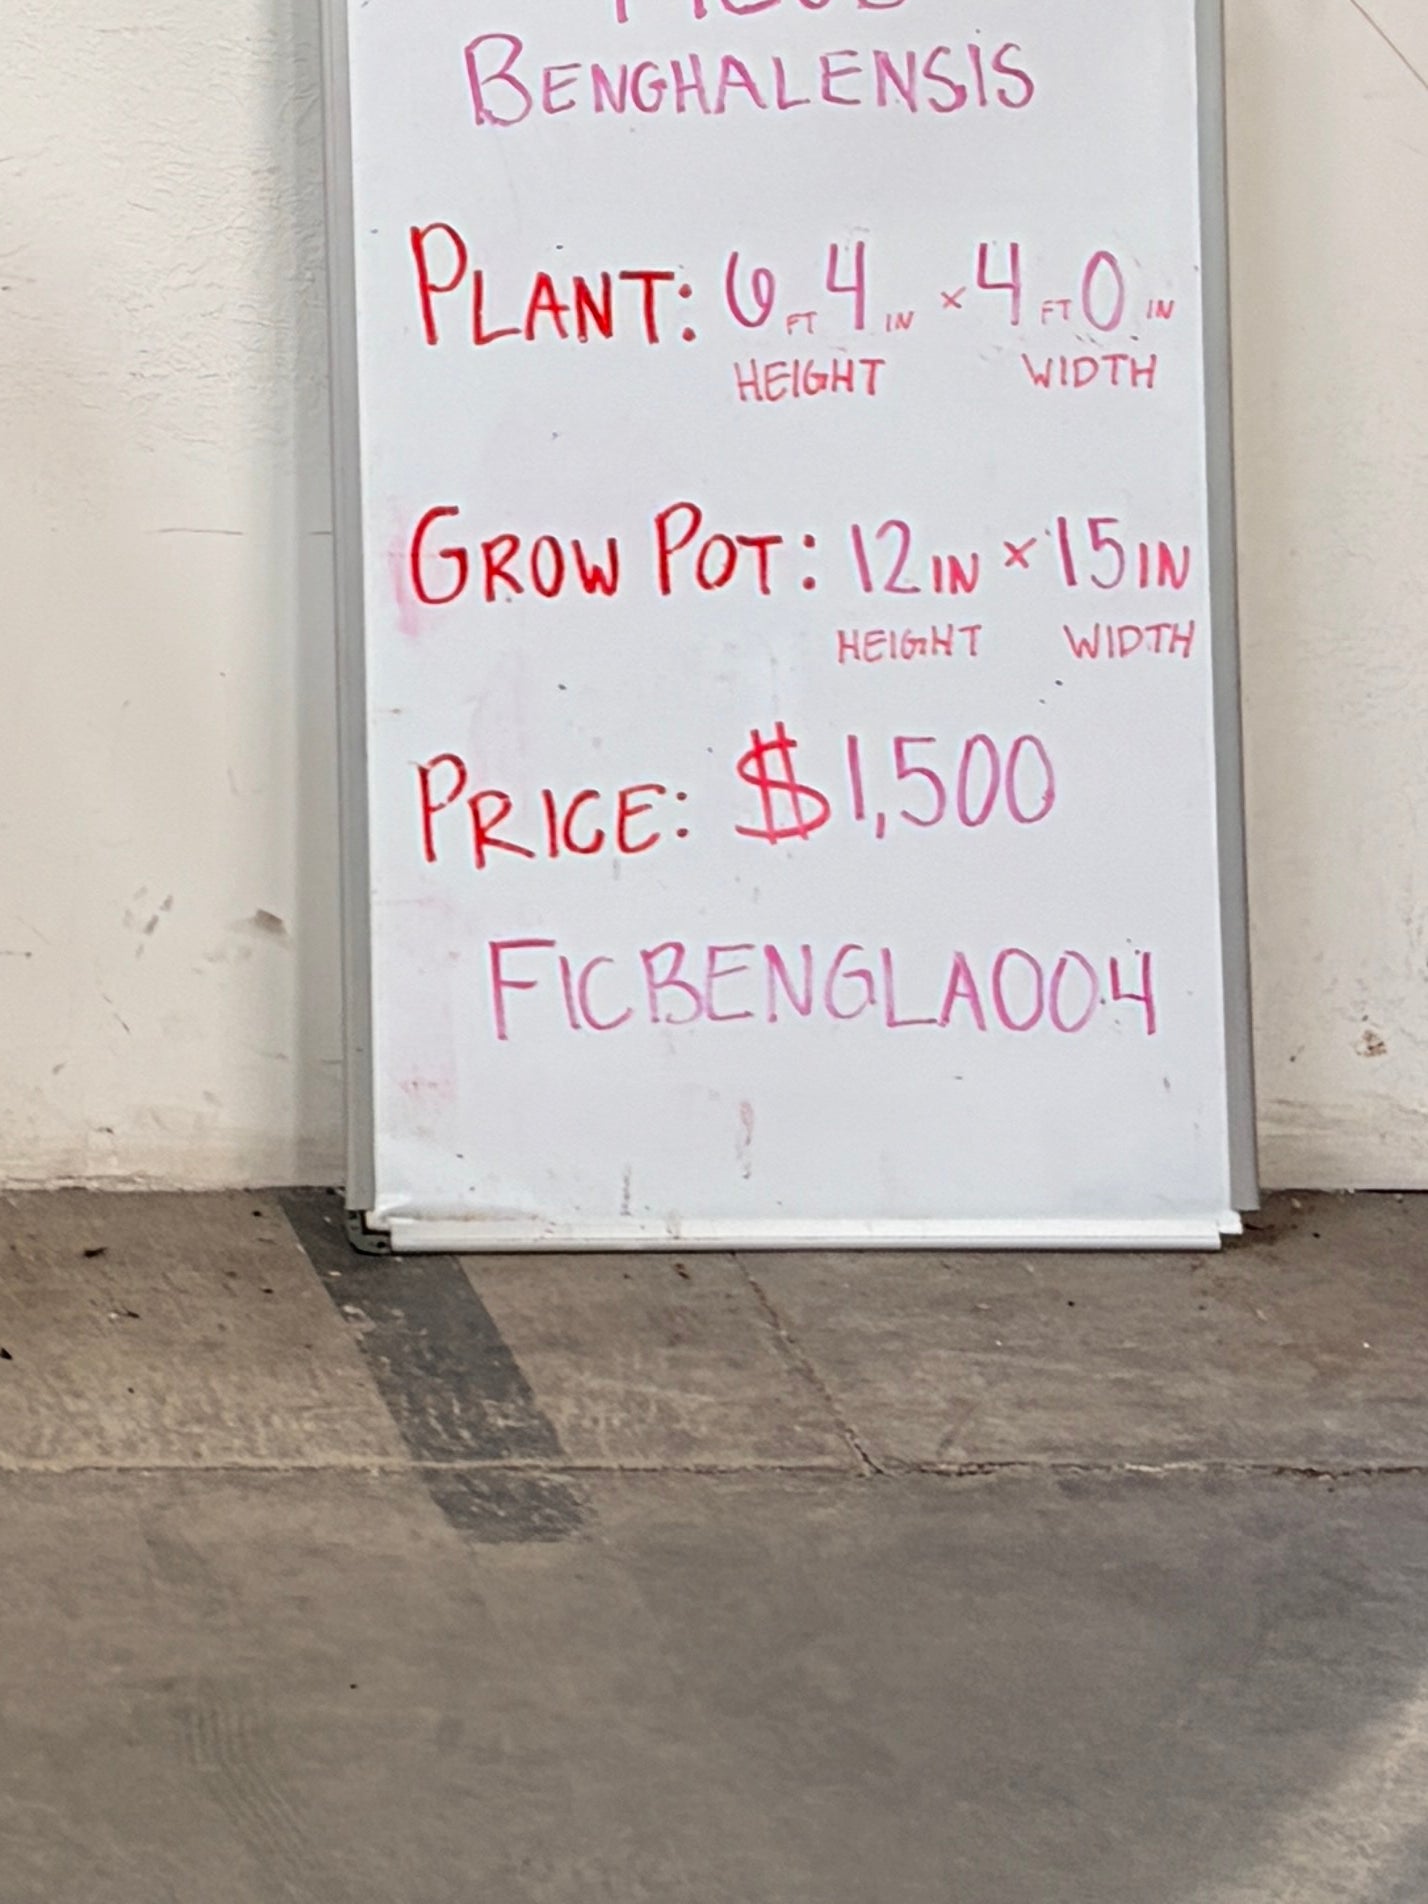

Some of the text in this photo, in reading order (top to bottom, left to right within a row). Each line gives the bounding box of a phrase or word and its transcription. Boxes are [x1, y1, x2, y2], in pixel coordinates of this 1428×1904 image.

[734, 358, 886, 403] HEIGHT
[1021, 352, 1156, 390] WIDTH
[836, 623, 983, 665] HEIGHT
[1063, 620, 1196, 659] WIDTH
[735, 720, 1055, 845] $1,500
